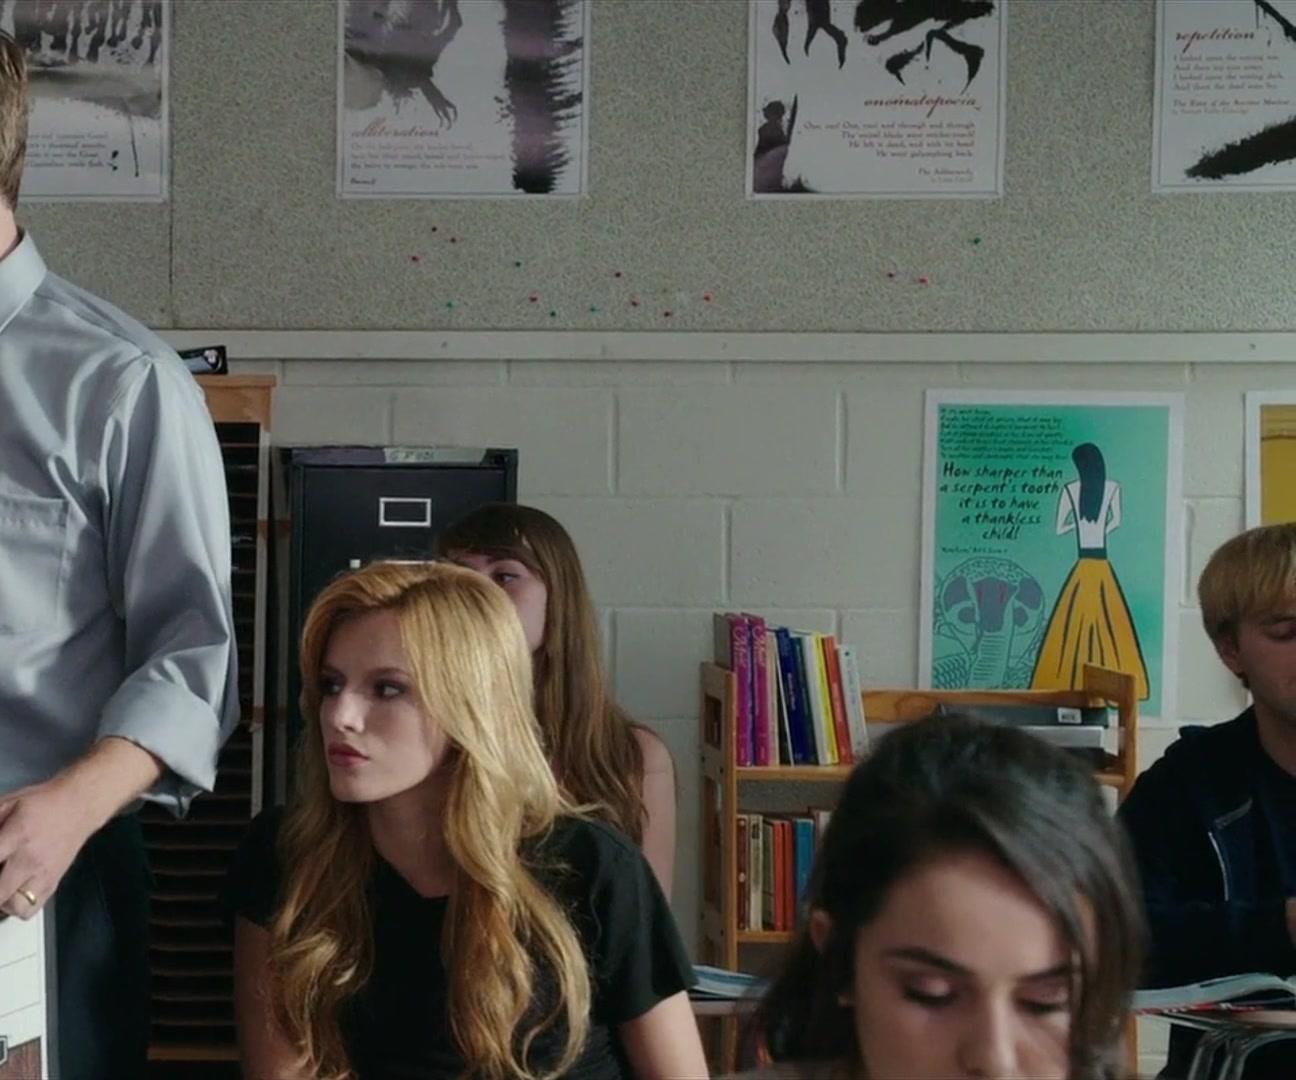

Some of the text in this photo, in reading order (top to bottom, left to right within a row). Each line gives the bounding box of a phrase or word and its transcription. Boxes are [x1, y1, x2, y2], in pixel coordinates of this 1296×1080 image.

[1176, 28, 1255, 54] repetition
[943, 461, 1064, 480] How sharper than
[940, 484, 948, 492] a
[953, 479, 1017, 496] serpent's
[959, 496, 1040, 510] it is to have
[962, 511, 1041, 525] a thankless
